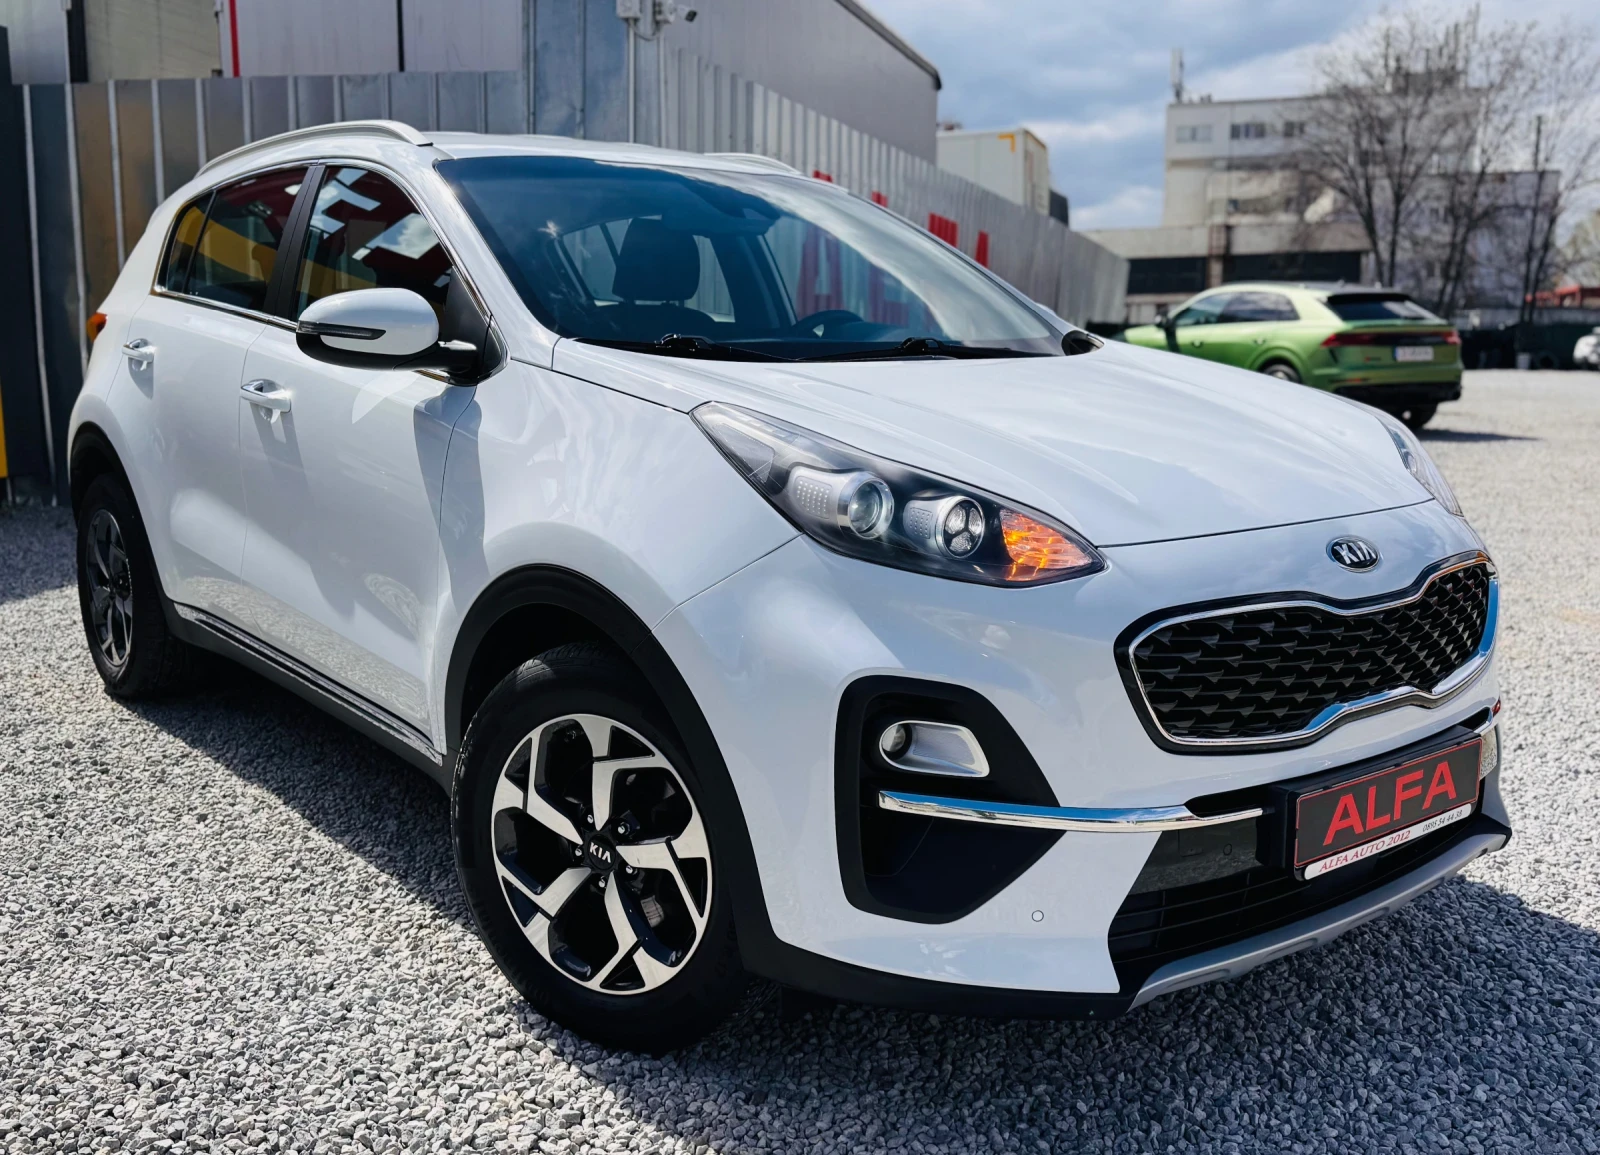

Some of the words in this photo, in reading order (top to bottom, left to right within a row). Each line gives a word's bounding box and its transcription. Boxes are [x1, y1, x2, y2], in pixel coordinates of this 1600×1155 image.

[1333, 541, 1377, 564] KIA
[1323, 761, 1456, 846] ALFA
[589, 841, 612, 864] KIA
[1319, 854, 1349, 873] ALFA
[1351, 841, 1385, 861] AUTO
[1386, 830, 1411, 847] 2012
